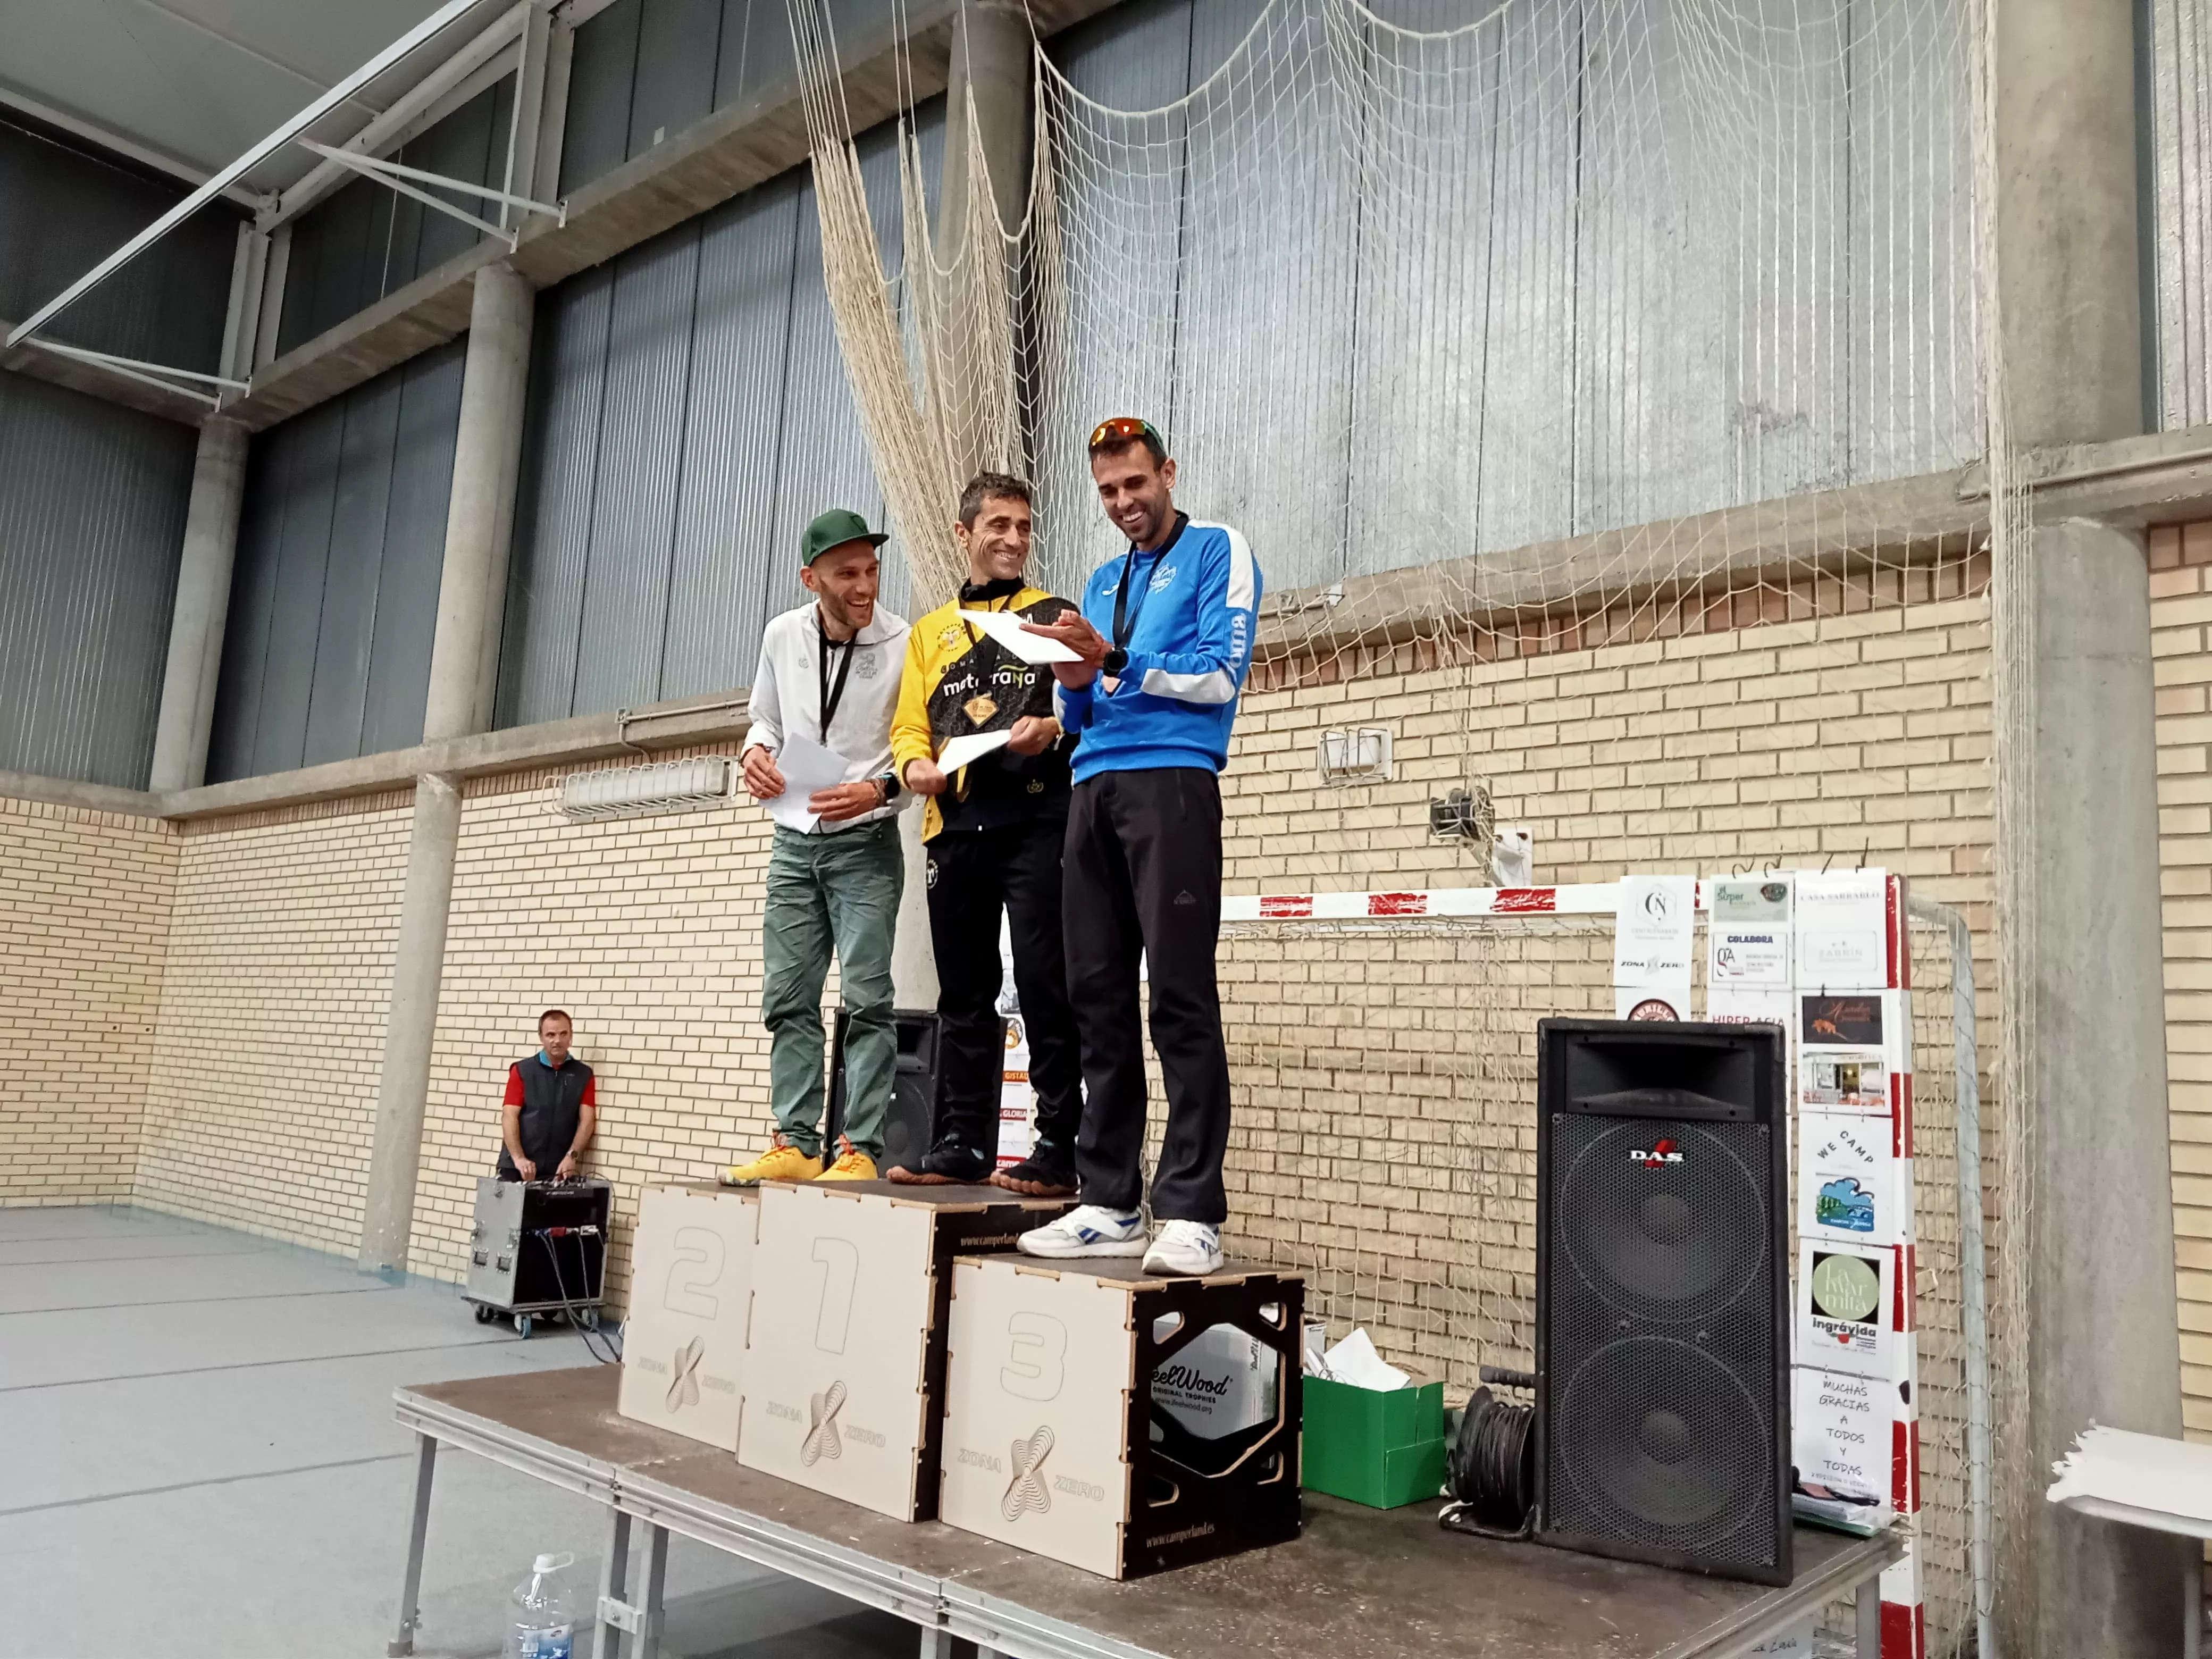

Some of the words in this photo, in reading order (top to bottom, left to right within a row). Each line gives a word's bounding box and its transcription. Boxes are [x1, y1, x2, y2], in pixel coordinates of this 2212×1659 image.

[941, 654, 1001, 674] COMAA
[943, 664, 1035, 697] matraña
[1727, 935, 1773, 944] COLABORA
[1817, 1142, 1837, 1159] WE
[1839, 1130, 1874, 1163] CAMP
[664, 1226, 726, 1320] 2
[811, 1237, 859, 1355] 1
[1812, 1317, 1877, 1338] ingrávida
[1000, 1311, 1069, 1402] 3
[1151, 1364, 1227, 1396] eelWood
[1823, 1380, 1868, 1396] MUCHAS
[1819, 1394, 1870, 1412] GRACIAS
[1840, 1415, 1848, 1425] A
[844, 1423, 886, 1448] ZERO
[1825, 1428, 1865, 1444] TODOS
[1840, 1446, 1847, 1456] Y
[957, 1448, 1002, 1474] ZONA
[1053, 1474, 1105, 1502] ZERO
[1823, 1460, 1863, 1476] TODAS
